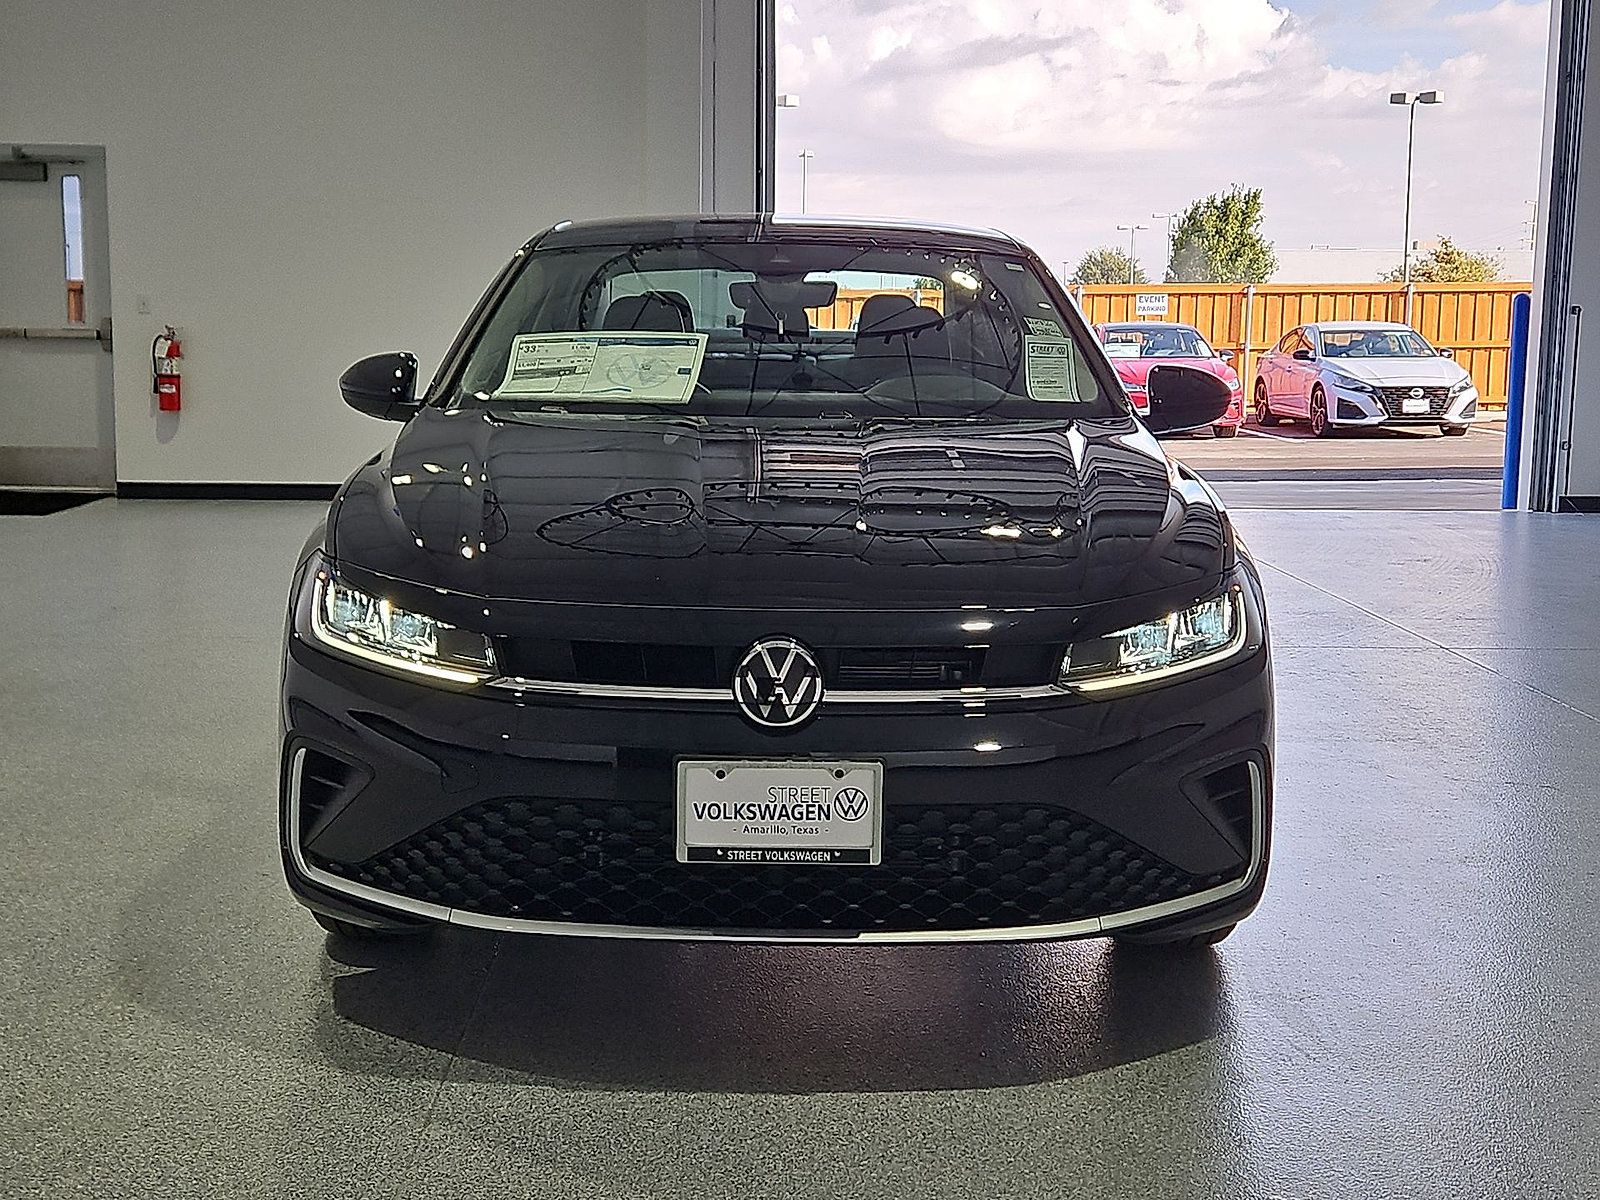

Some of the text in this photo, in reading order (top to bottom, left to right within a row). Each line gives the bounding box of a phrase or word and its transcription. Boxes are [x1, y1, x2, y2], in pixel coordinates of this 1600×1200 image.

[1138, 295, 1166, 303] EVENT
[767, 787, 831, 803] STREET
[693, 803, 831, 820] VOLKSWAGEN
[742, 825, 820, 836] Amarillo, Texas
[727, 850, 831, 861] STREET VOLKSWAGEN
